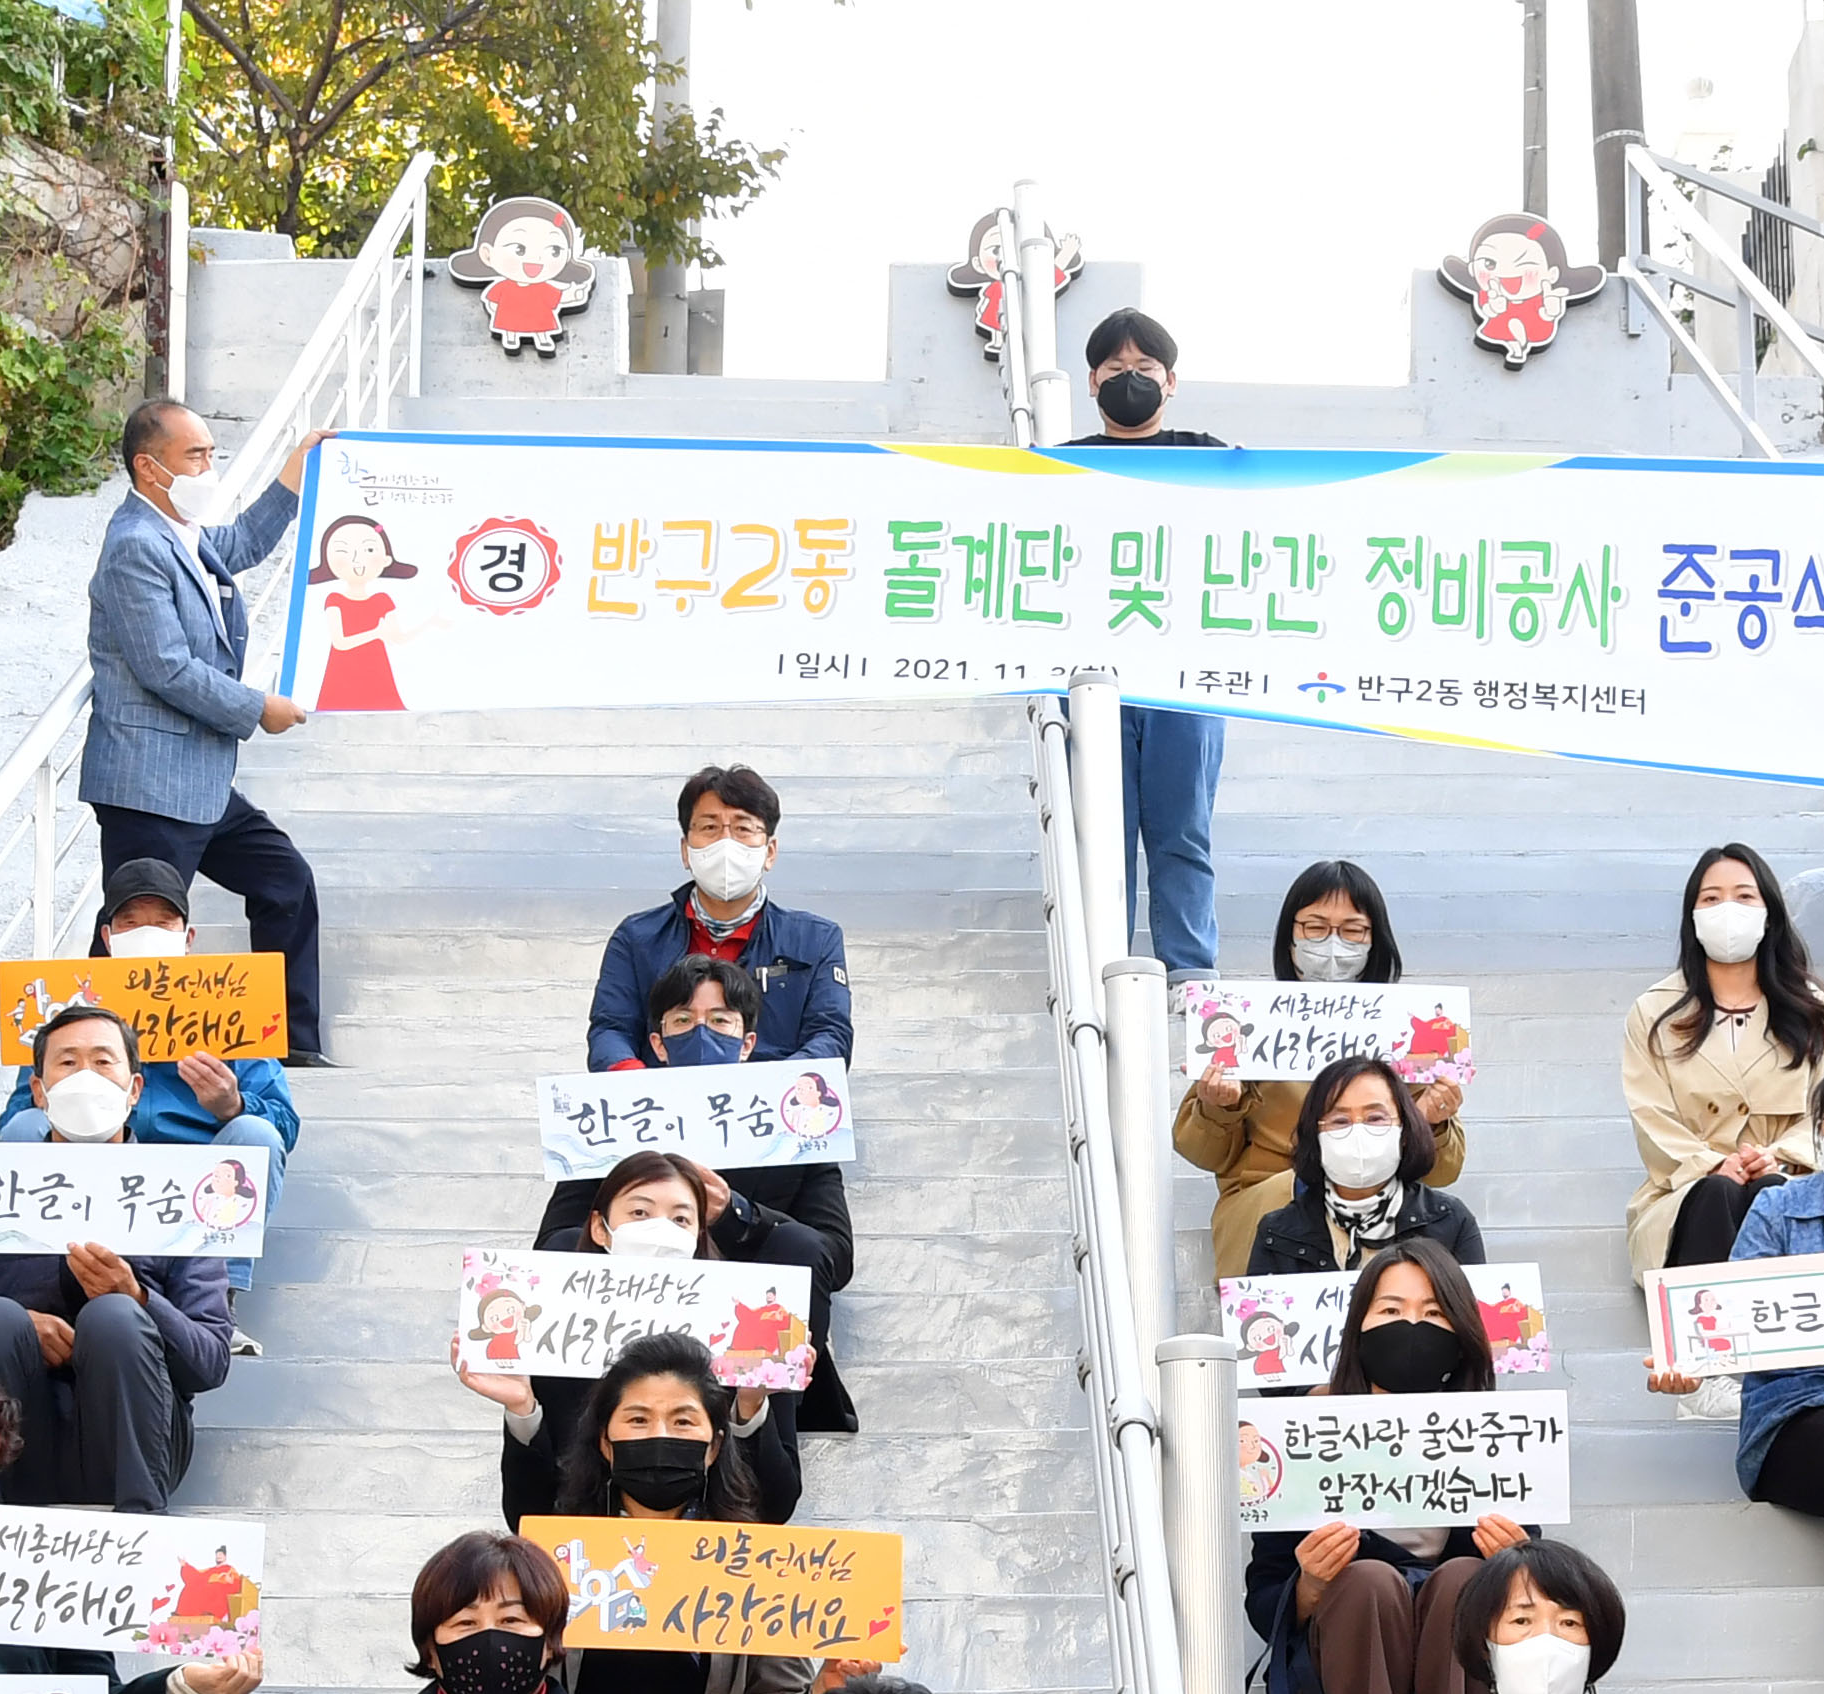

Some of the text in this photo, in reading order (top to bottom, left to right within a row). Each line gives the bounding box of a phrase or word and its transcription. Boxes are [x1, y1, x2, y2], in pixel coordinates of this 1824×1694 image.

[479, 542, 529, 595] 경
[586, 517, 852, 616] 반구2동
[884, 520, 1074, 625] 돌계단
[1108, 526, 1165, 631] 및
[1200, 532, 1327, 634] 난간
[1366, 535, 1623, 650] 정비공사
[1357, 674, 1464, 708] 반구2동
[1472, 679, 1647, 716] 행정복지센터
[1270, 993, 1384, 1022] 세종대왕님
[567, 1093, 775, 1149] 한글이 목숨
[117, 1176, 186, 1233] 목숨
[562, 1268, 705, 1306] 세종대왕님
[1284, 1411, 1564, 1462] 한글사랑 울산중구가
[1318, 1467, 1533, 1514] 앞장서겠습니다
[663, 1583, 861, 1651] 사랑해요
